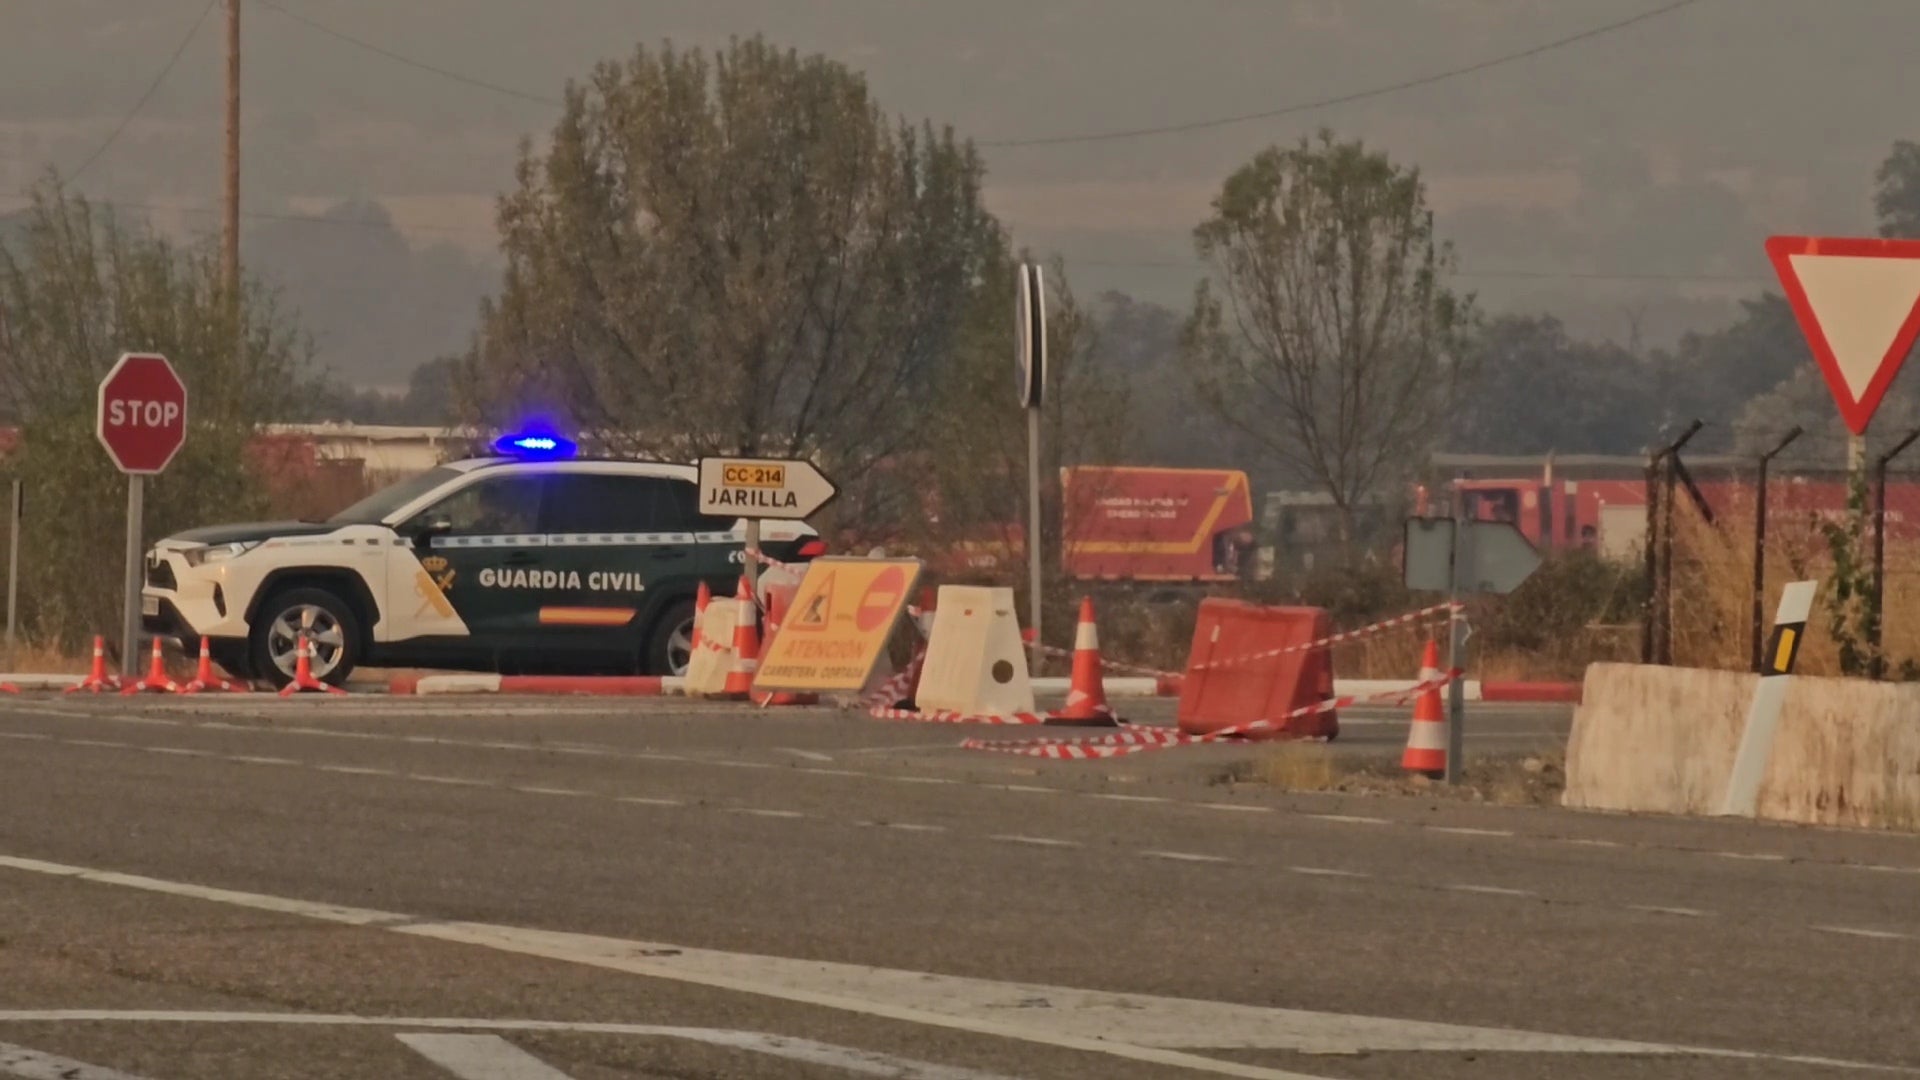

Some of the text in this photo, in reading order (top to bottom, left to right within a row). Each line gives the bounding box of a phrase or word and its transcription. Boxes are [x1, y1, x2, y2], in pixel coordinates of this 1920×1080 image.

[110, 399, 179, 428] STOP
[726, 468, 781, 482] CC-214
[708, 488, 797, 508] JARILLA
[479, 568, 645, 592] GUARDIA CIVIL
[762, 665, 864, 679] CARRETERA CORTADA
